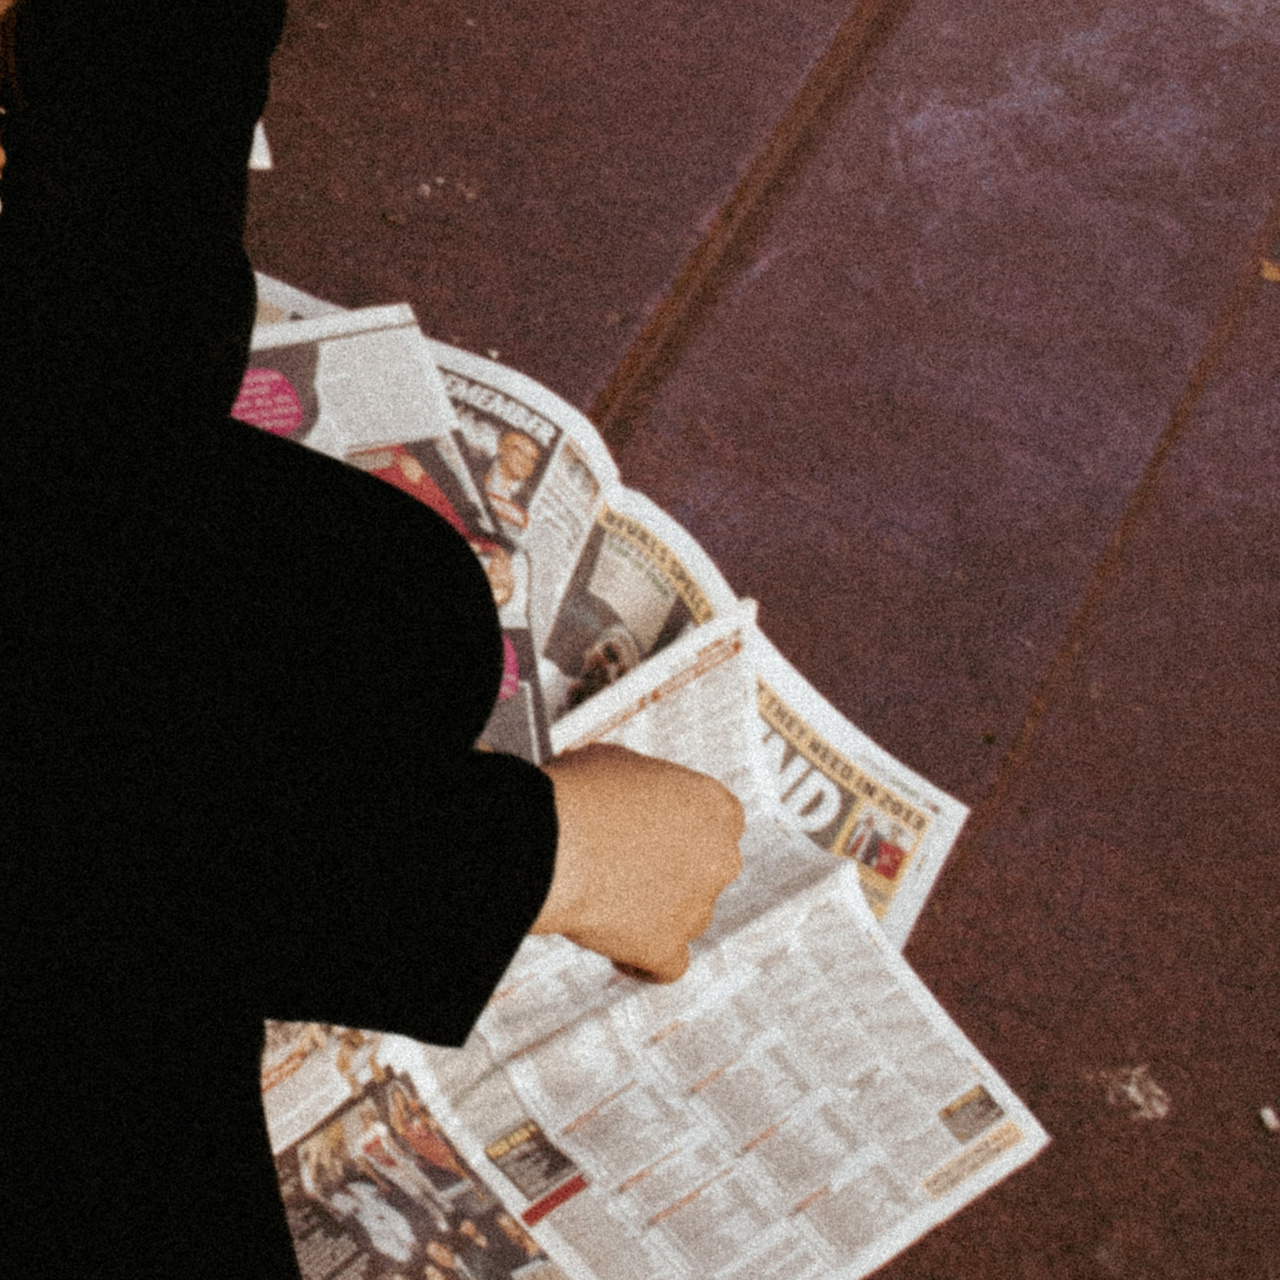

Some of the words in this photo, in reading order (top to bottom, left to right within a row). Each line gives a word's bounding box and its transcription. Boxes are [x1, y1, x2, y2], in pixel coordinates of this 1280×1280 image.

[442, 373, 557, 448] EMEMBER
[806, 736, 855, 781] NEED
[853, 774, 879, 799] IN
